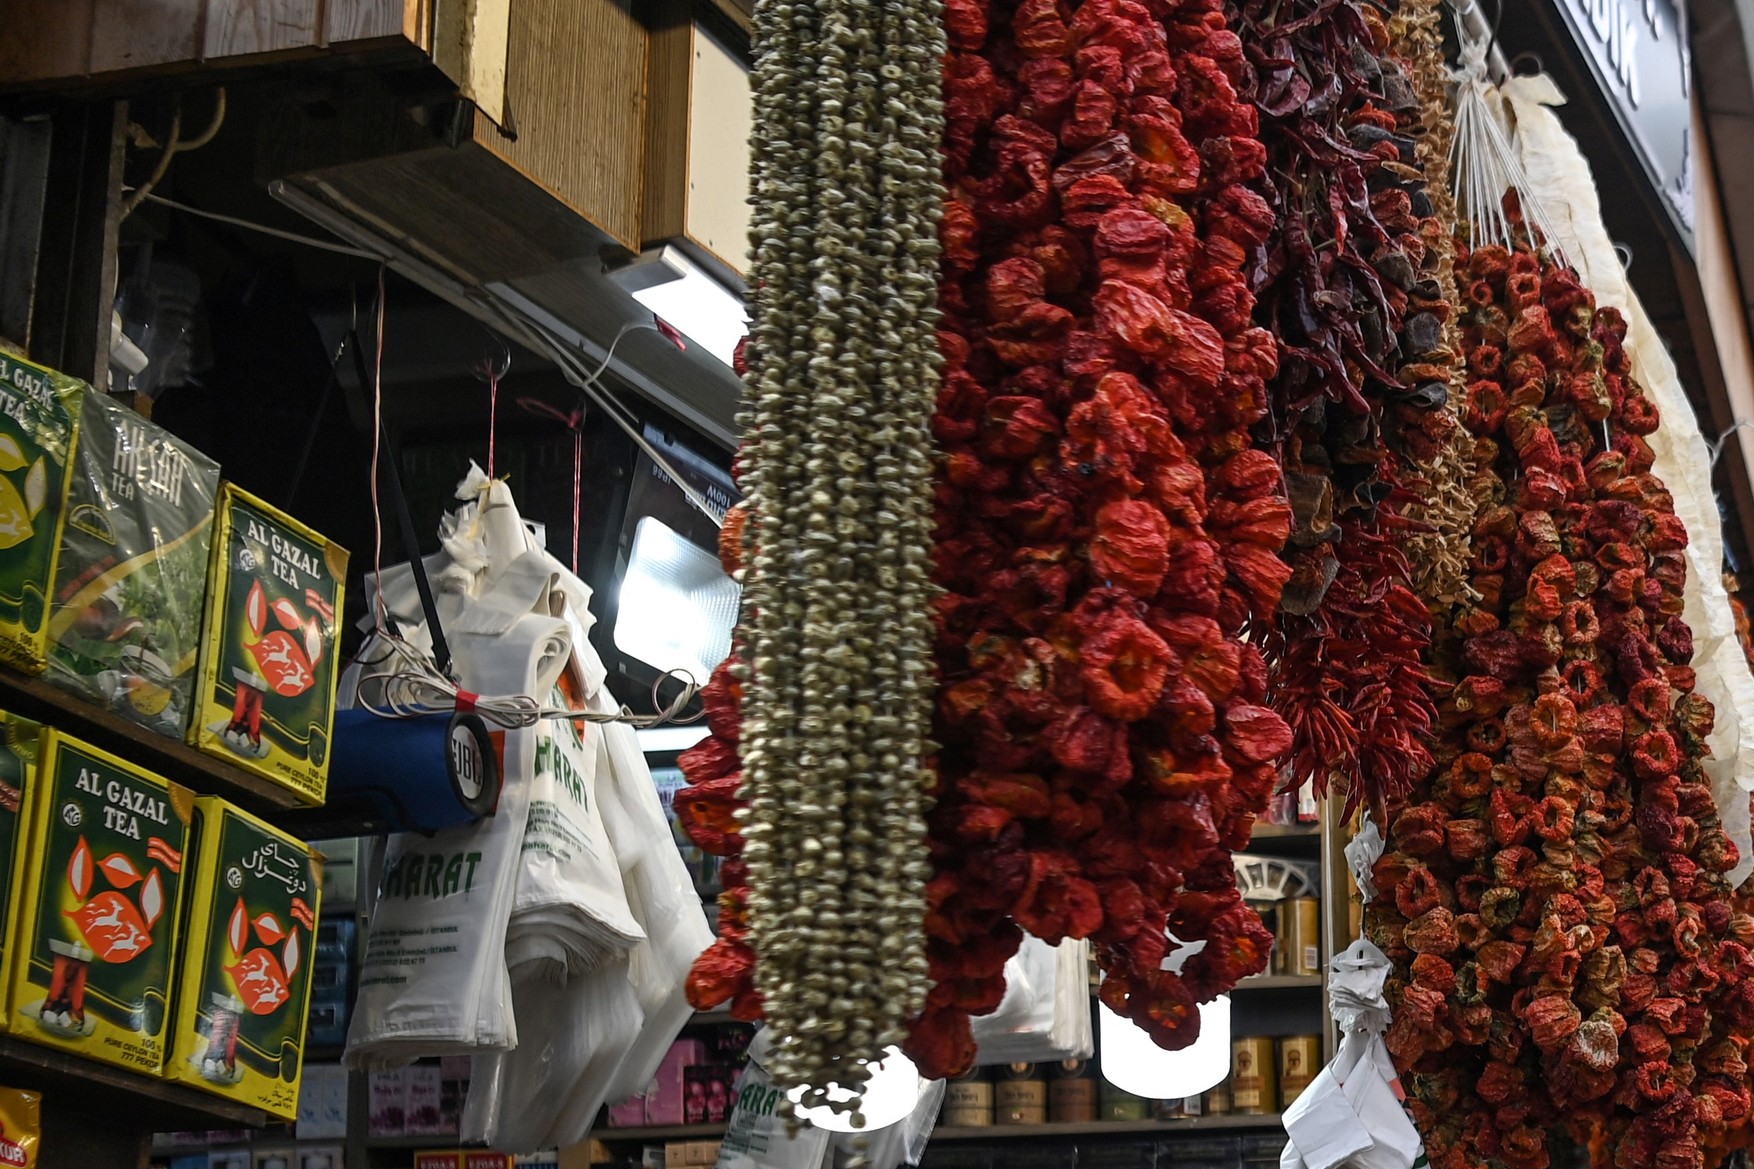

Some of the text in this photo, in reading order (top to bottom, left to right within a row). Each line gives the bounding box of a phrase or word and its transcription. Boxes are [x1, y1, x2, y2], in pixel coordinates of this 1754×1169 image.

[112, 472, 134, 500] TEA
[248, 520, 320, 580] AL GAZAL
[271, 554, 299, 590] TEA
[456, 740, 481, 786] JBL
[75, 767, 168, 826] AL GAZAL
[103, 805, 141, 840] TEA
[104, 1037, 123, 1048] PURE
[123, 1043, 148, 1056] CEYLON
[121, 1051, 135, 1061] 777
